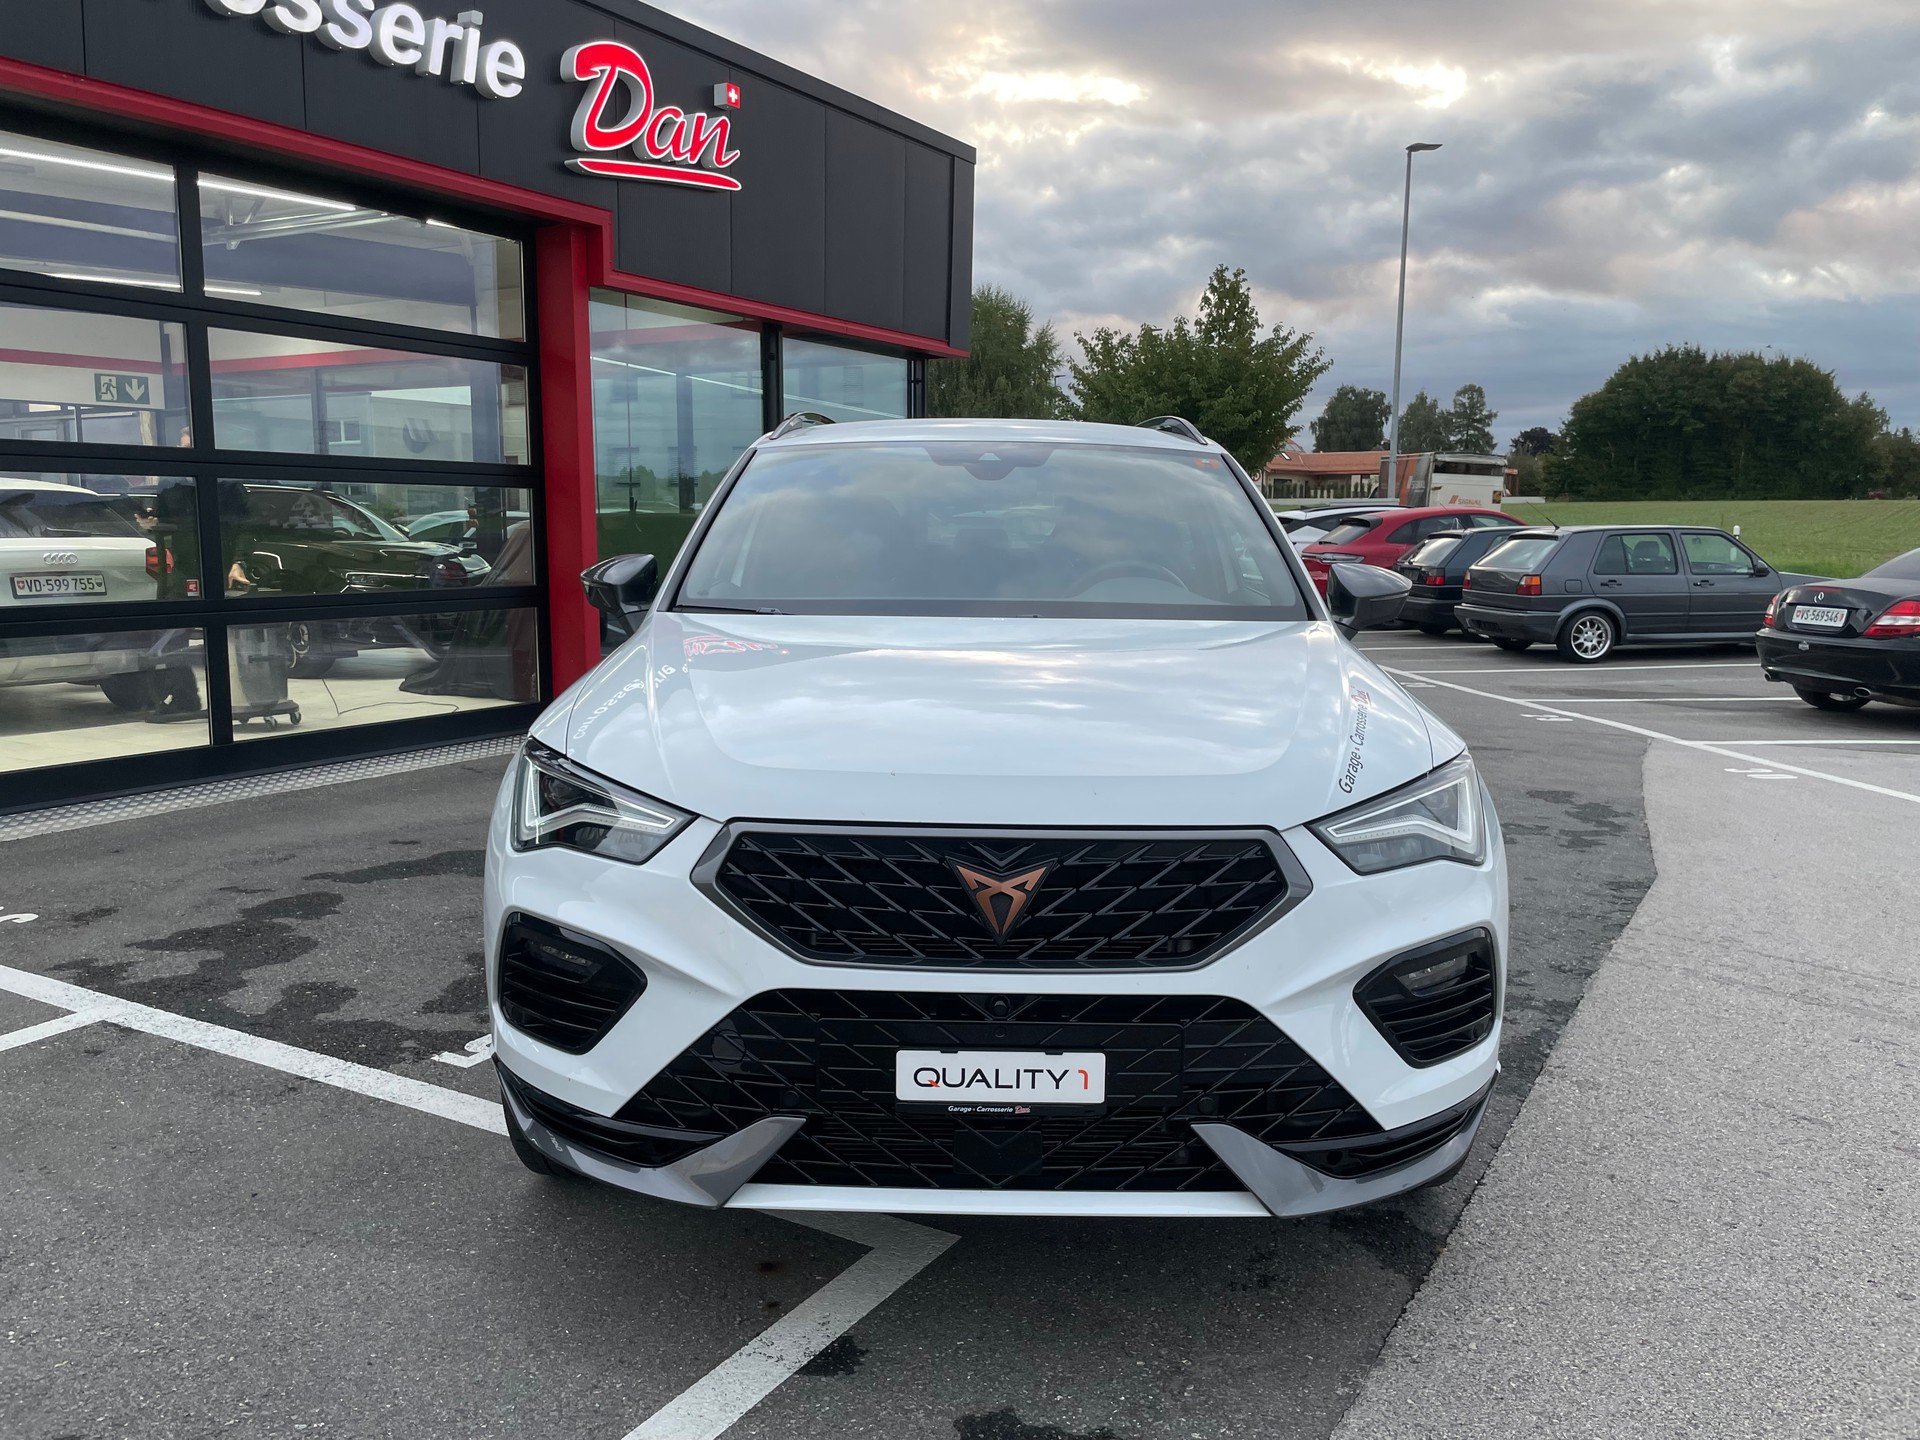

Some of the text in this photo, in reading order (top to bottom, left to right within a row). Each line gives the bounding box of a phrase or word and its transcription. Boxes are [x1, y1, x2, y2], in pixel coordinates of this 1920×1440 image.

[207, 0, 741, 172] sserie Dan
[1338, 750, 1364, 794] Garage
[913, 1066, 1088, 1090] QUALITY 1
[947, 1104, 972, 1114] Garage
[976, 1105, 1014, 1114] Carrosserie
